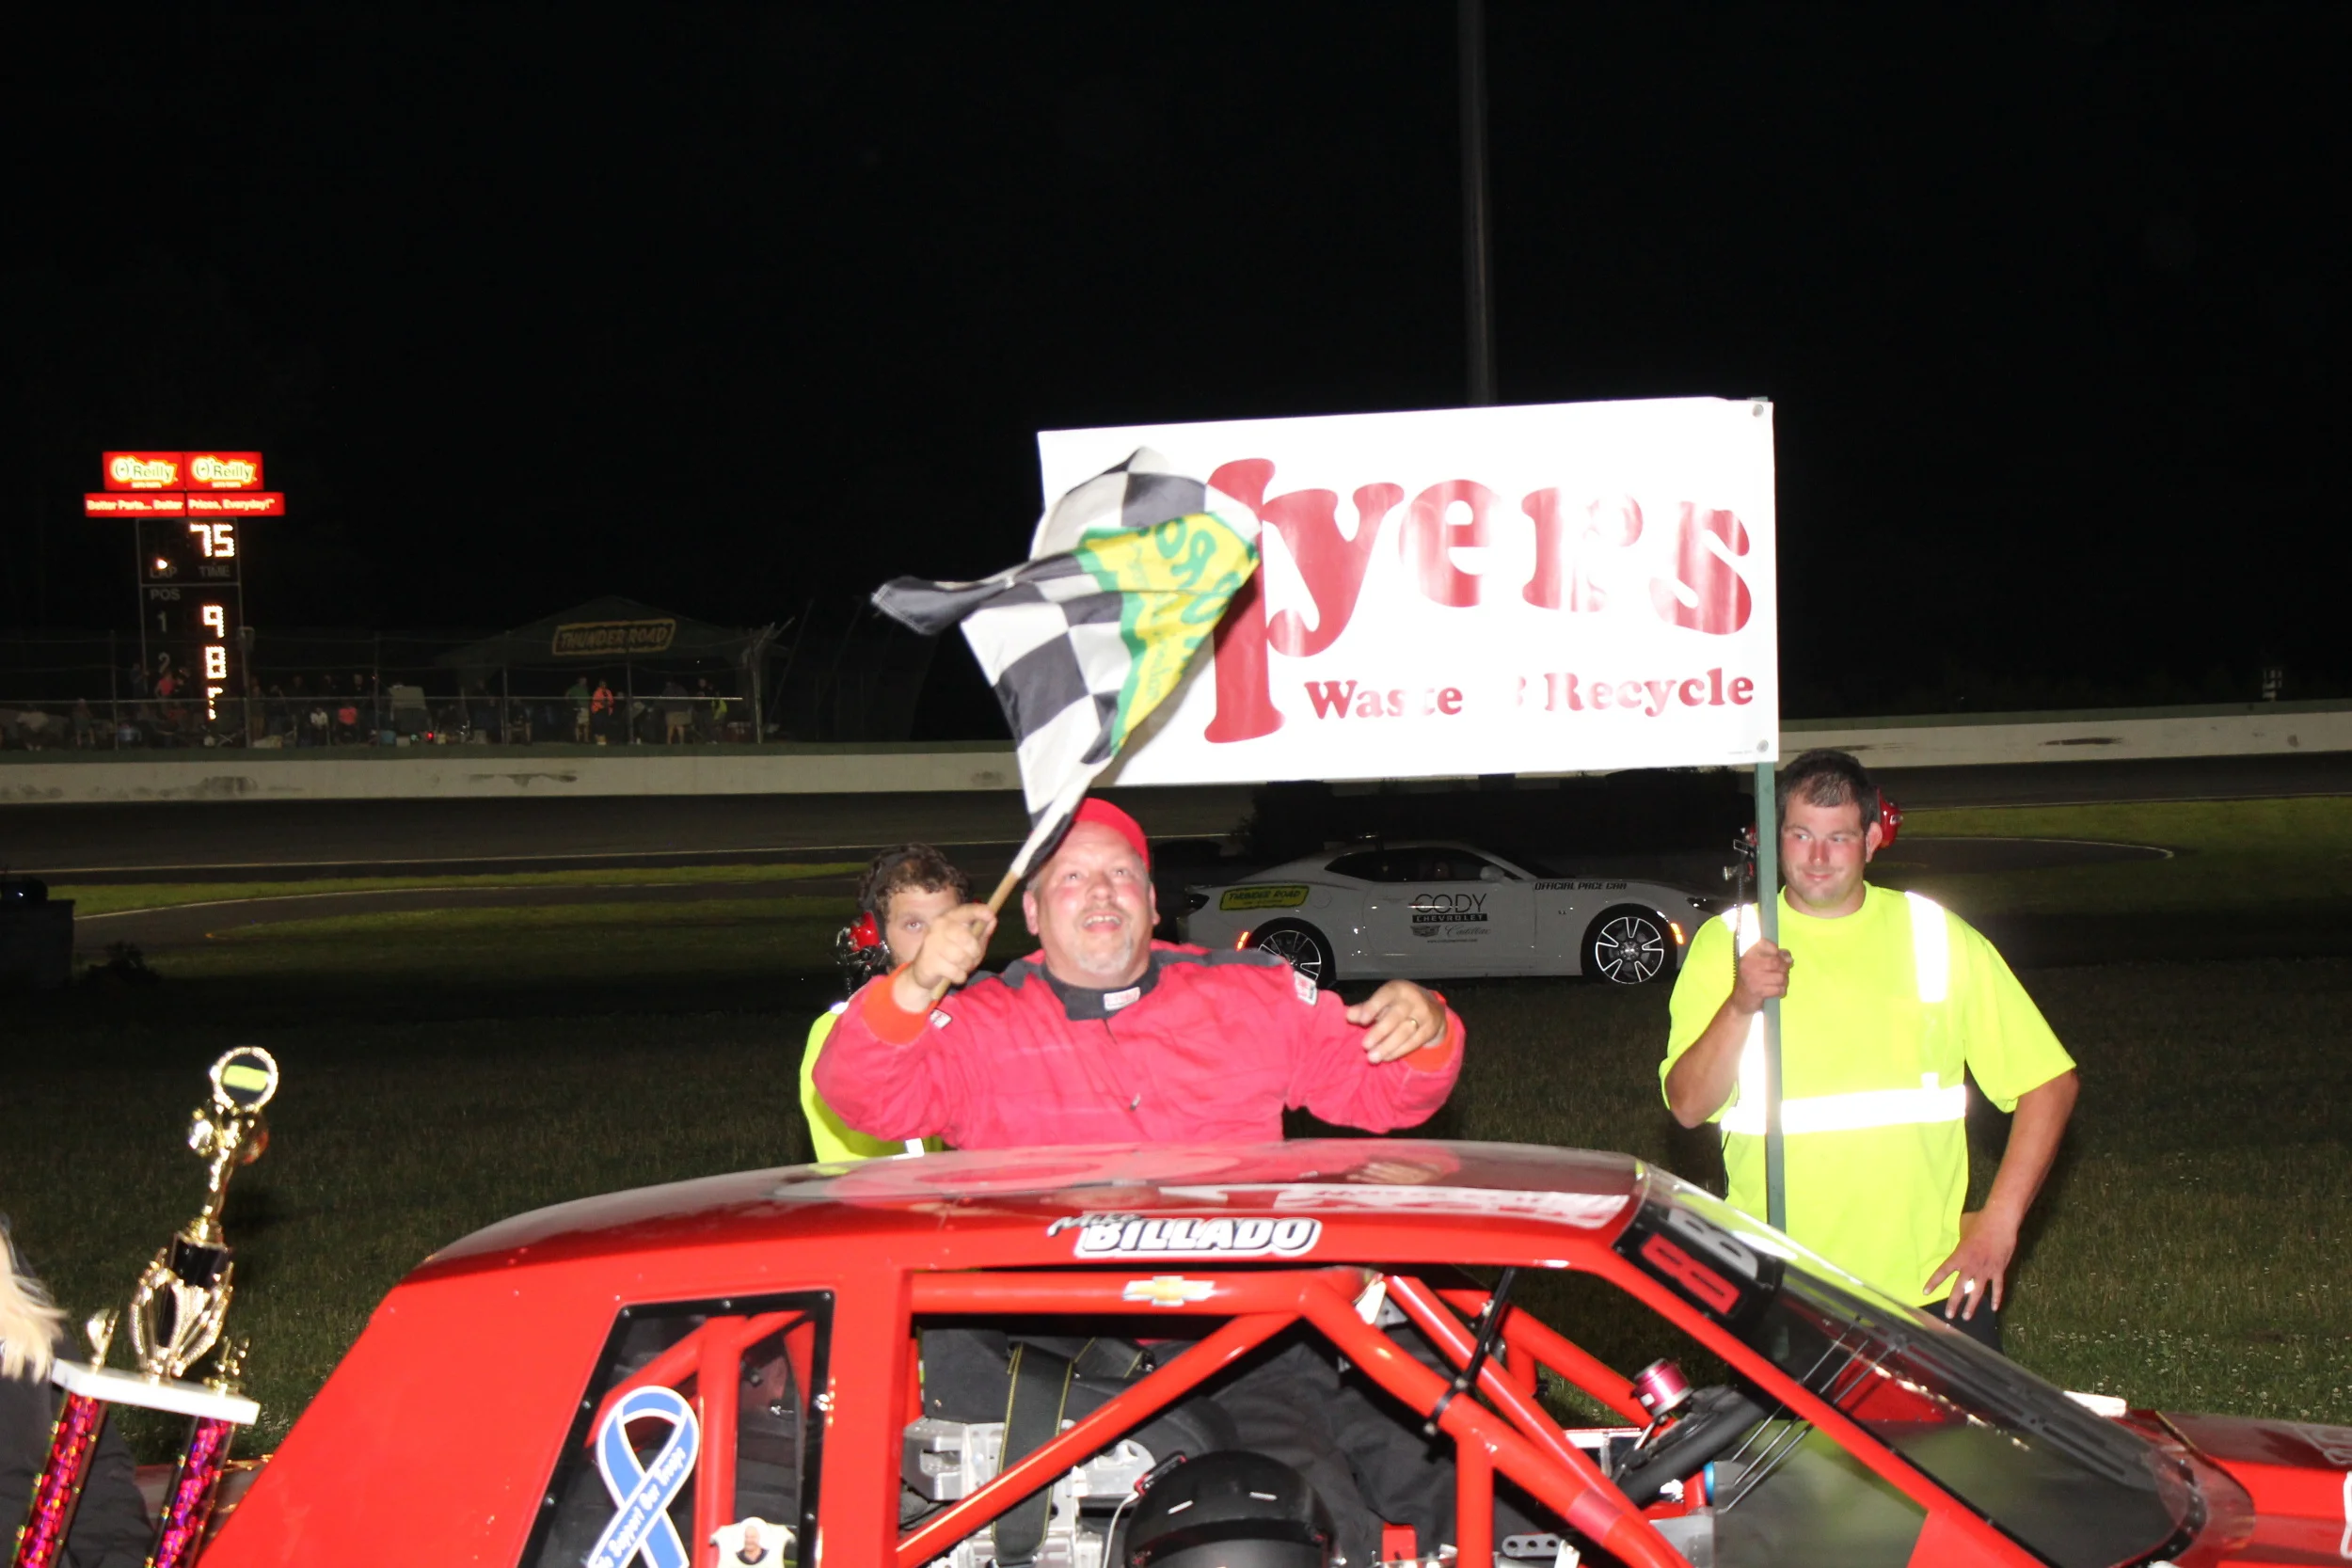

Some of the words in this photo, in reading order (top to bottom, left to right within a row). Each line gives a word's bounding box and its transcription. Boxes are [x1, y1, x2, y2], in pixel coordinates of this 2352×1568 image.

[113, 459, 174, 482] O'Reilly
[194, 459, 254, 482] O'Reilly
[189, 523, 235, 558] 75
[198, 564, 230, 578] TIME
[149, 588, 181, 601] POS
[157, 610, 167, 633] 1
[201, 605, 225, 639] 9
[561, 628, 625, 648] THUNDER
[628, 626, 669, 643] ROAD
[204, 645, 228, 679] 8
[1544, 666, 1754, 718] Recycle
[1273, 889, 1301, 898] ROAD
[1534, 881, 1575, 891] OFFICIAL
[1414, 893, 1487, 914] CODY
[1416, 913, 1484, 923] CHEVROLET
[1080, 1217, 1320, 1253] BILLADO
